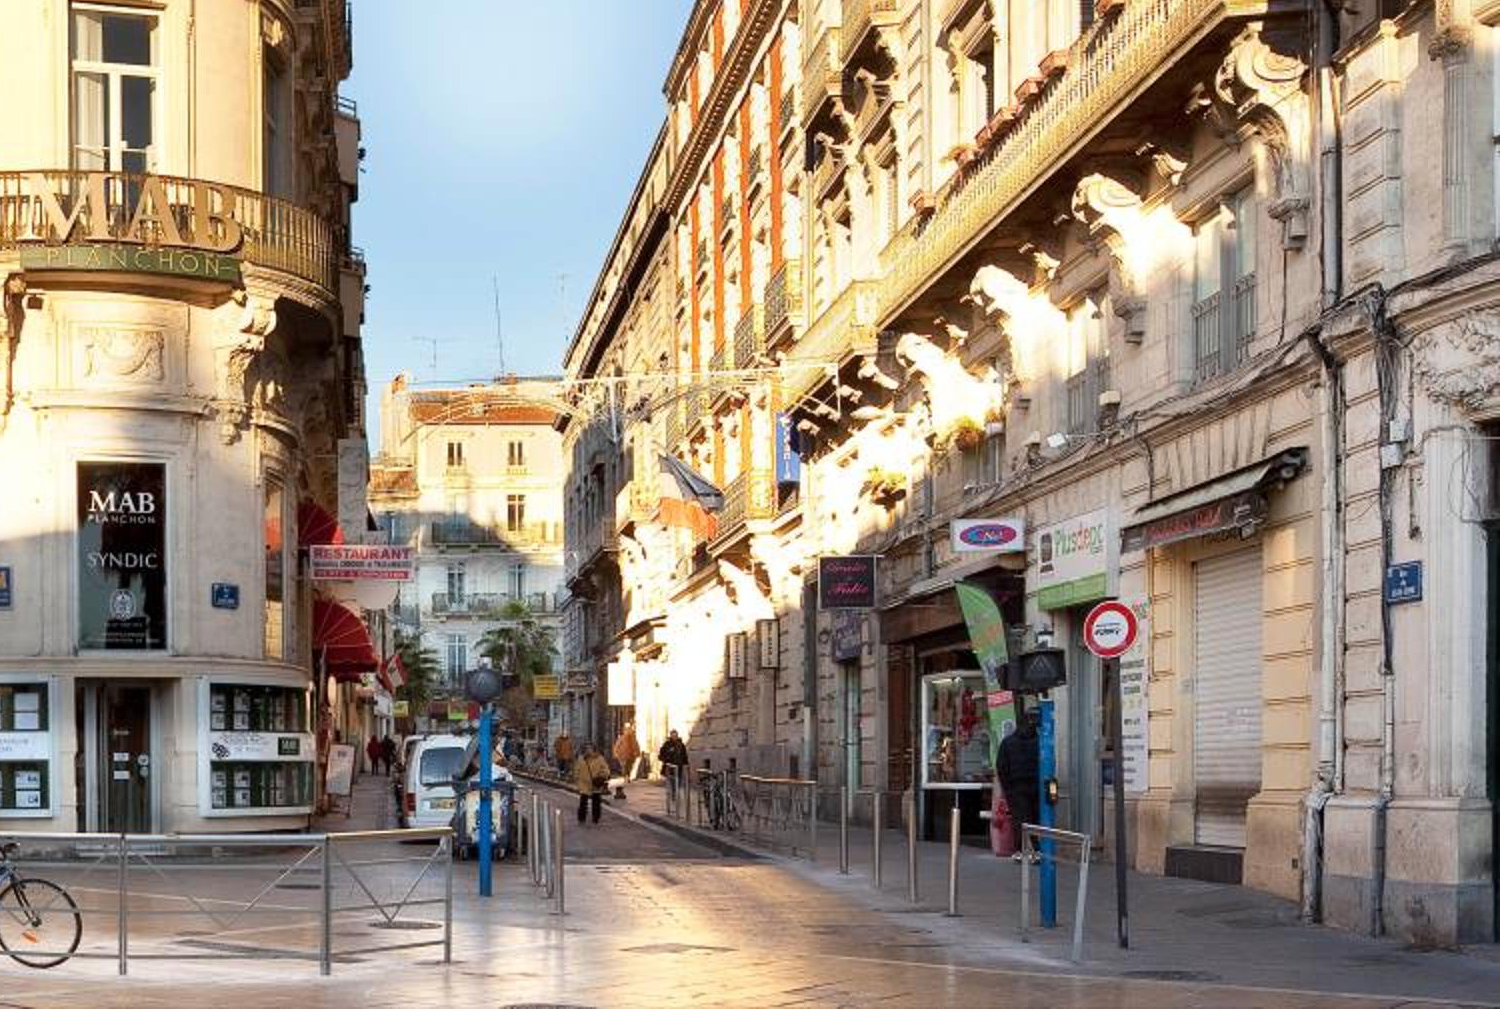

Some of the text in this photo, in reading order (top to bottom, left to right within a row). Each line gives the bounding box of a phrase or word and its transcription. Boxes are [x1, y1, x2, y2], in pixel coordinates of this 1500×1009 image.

[17, 172, 245, 254] MAB
[46, 247, 220, 276] PLANCHON
[88, 490, 156, 514] MAB
[87, 514, 156, 524] PLANCHON
[88, 552, 157, 569] SYNDIC
[312, 547, 411, 560] RESTAURANT
